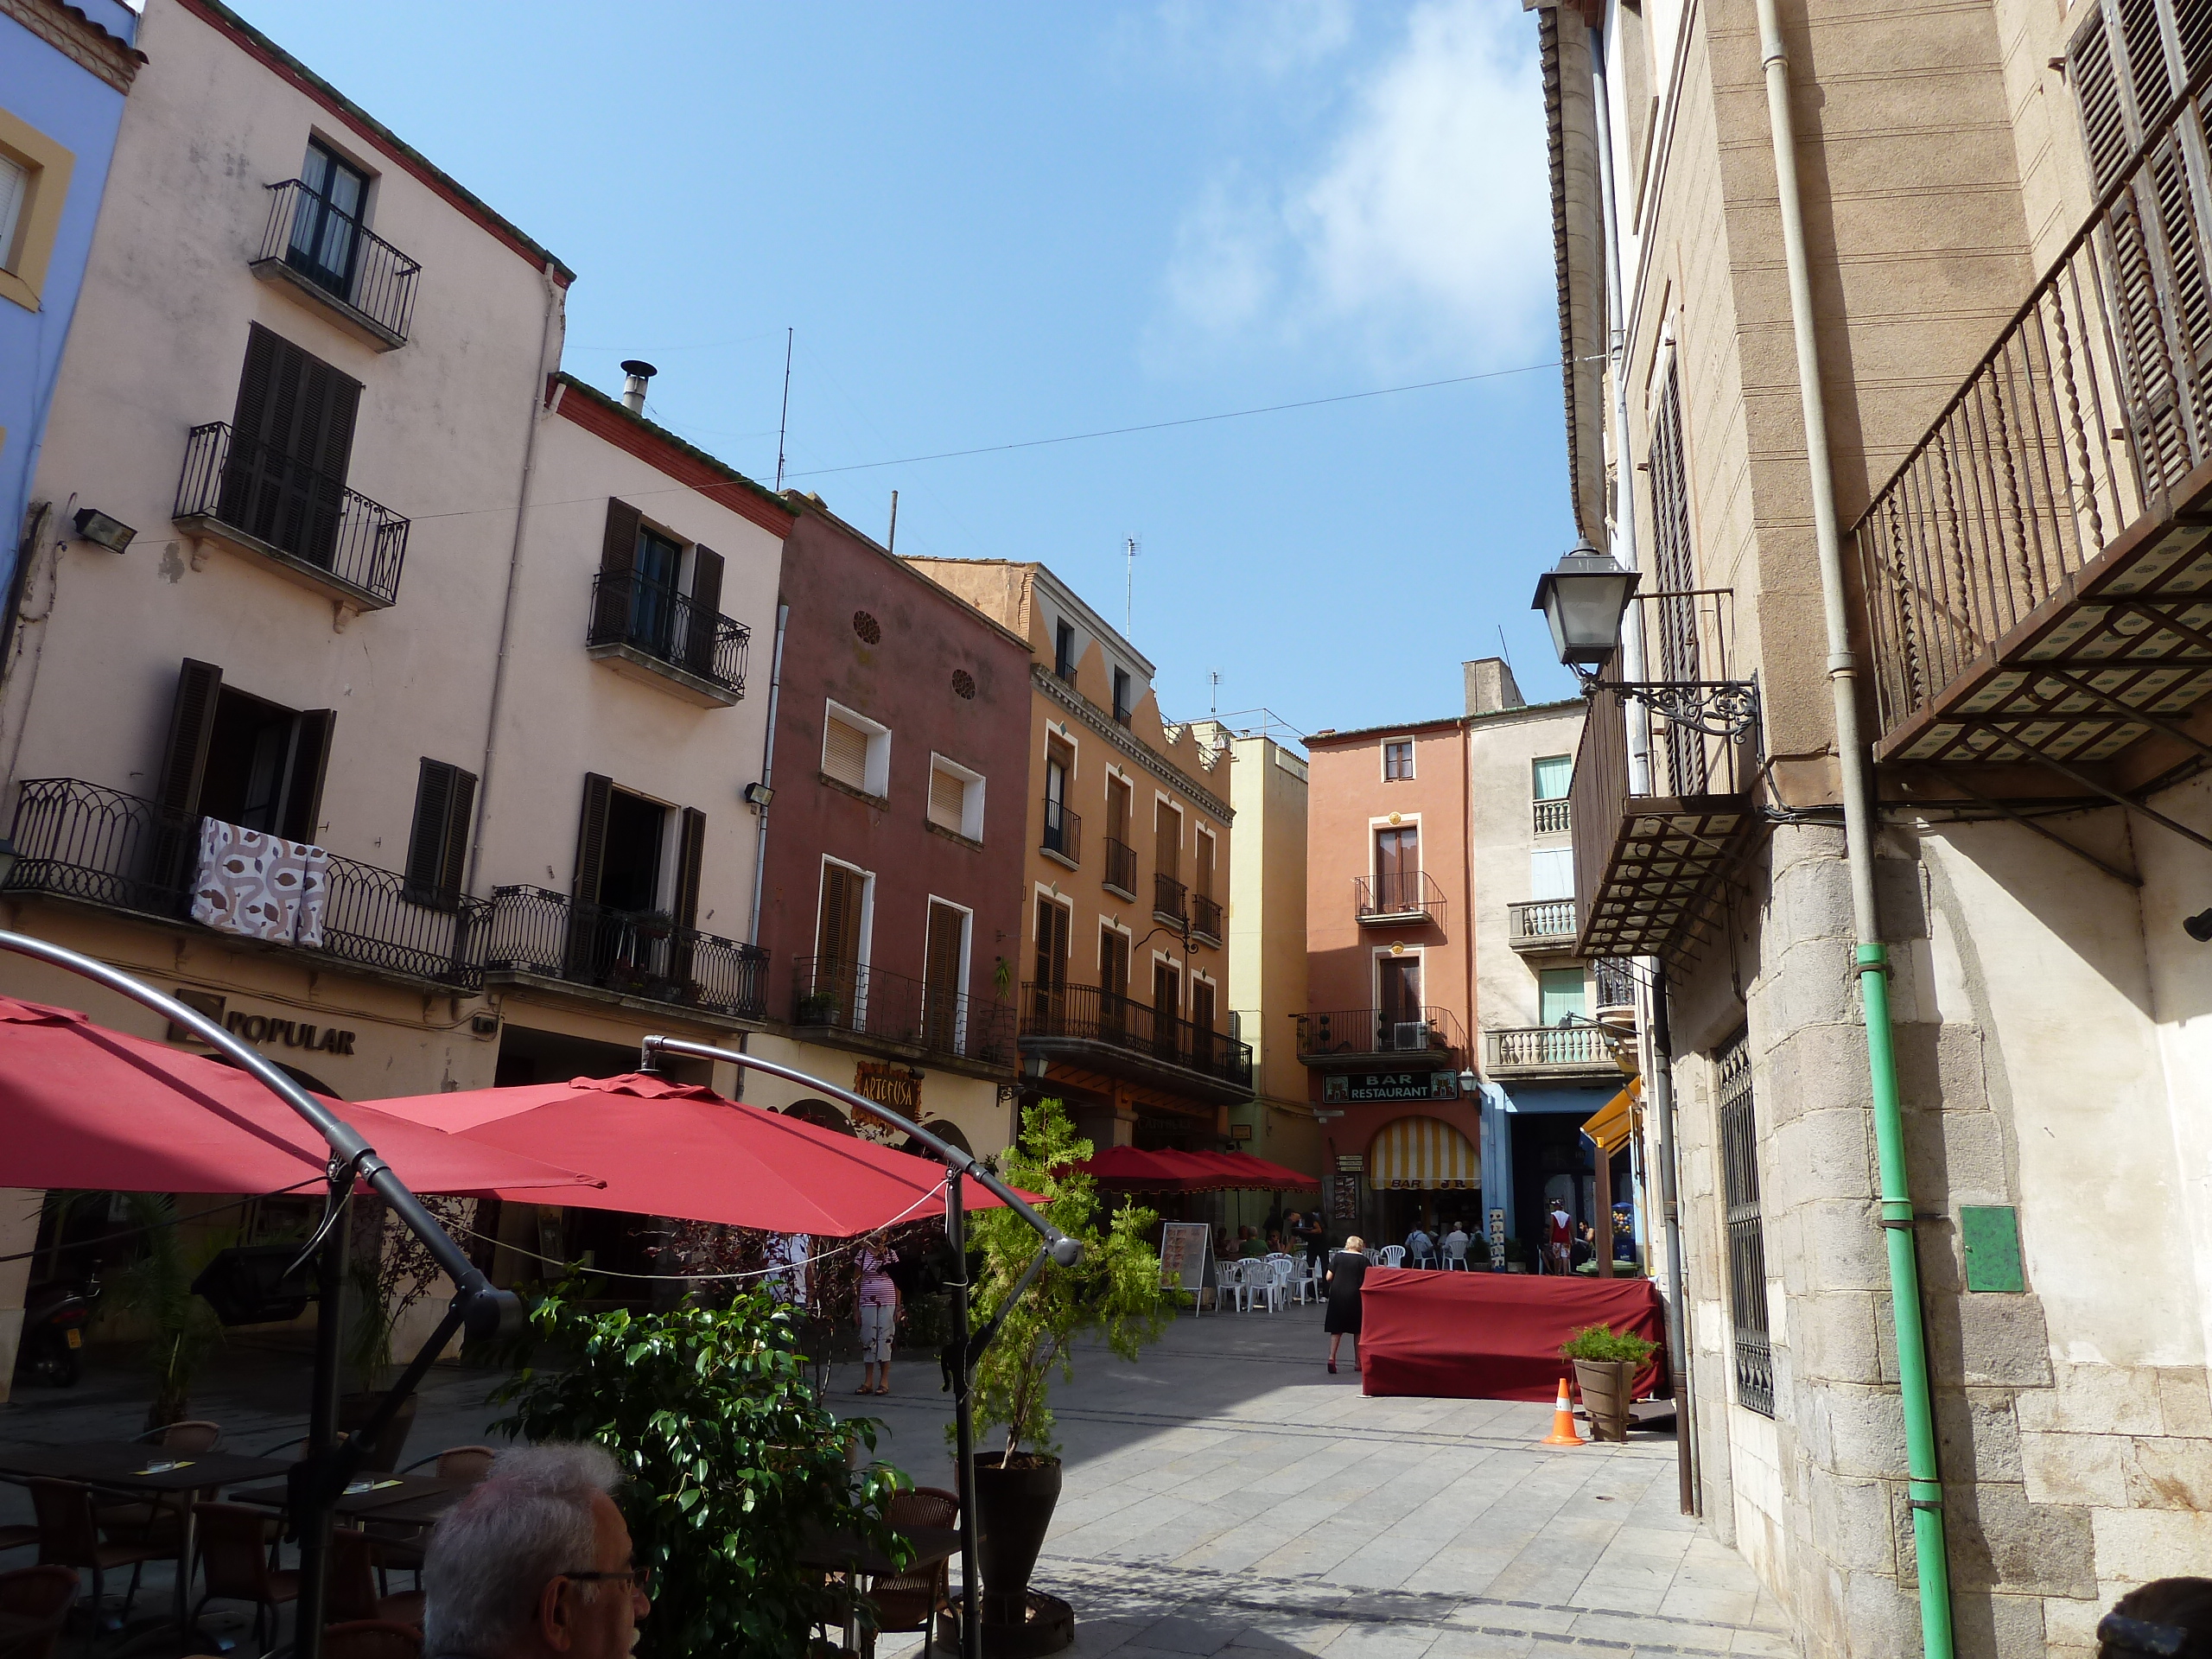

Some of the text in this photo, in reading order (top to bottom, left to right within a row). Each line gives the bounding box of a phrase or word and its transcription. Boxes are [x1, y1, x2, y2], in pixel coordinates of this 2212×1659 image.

[226, 1011, 356, 1055] POPULAR
[1366, 1074, 1412, 1085] BAR
[862, 1077, 912, 1106] ARTEFUSA
[1351, 1086, 1428, 1098] RESTAURANT
[1391, 1179, 1421, 1188] BAR
